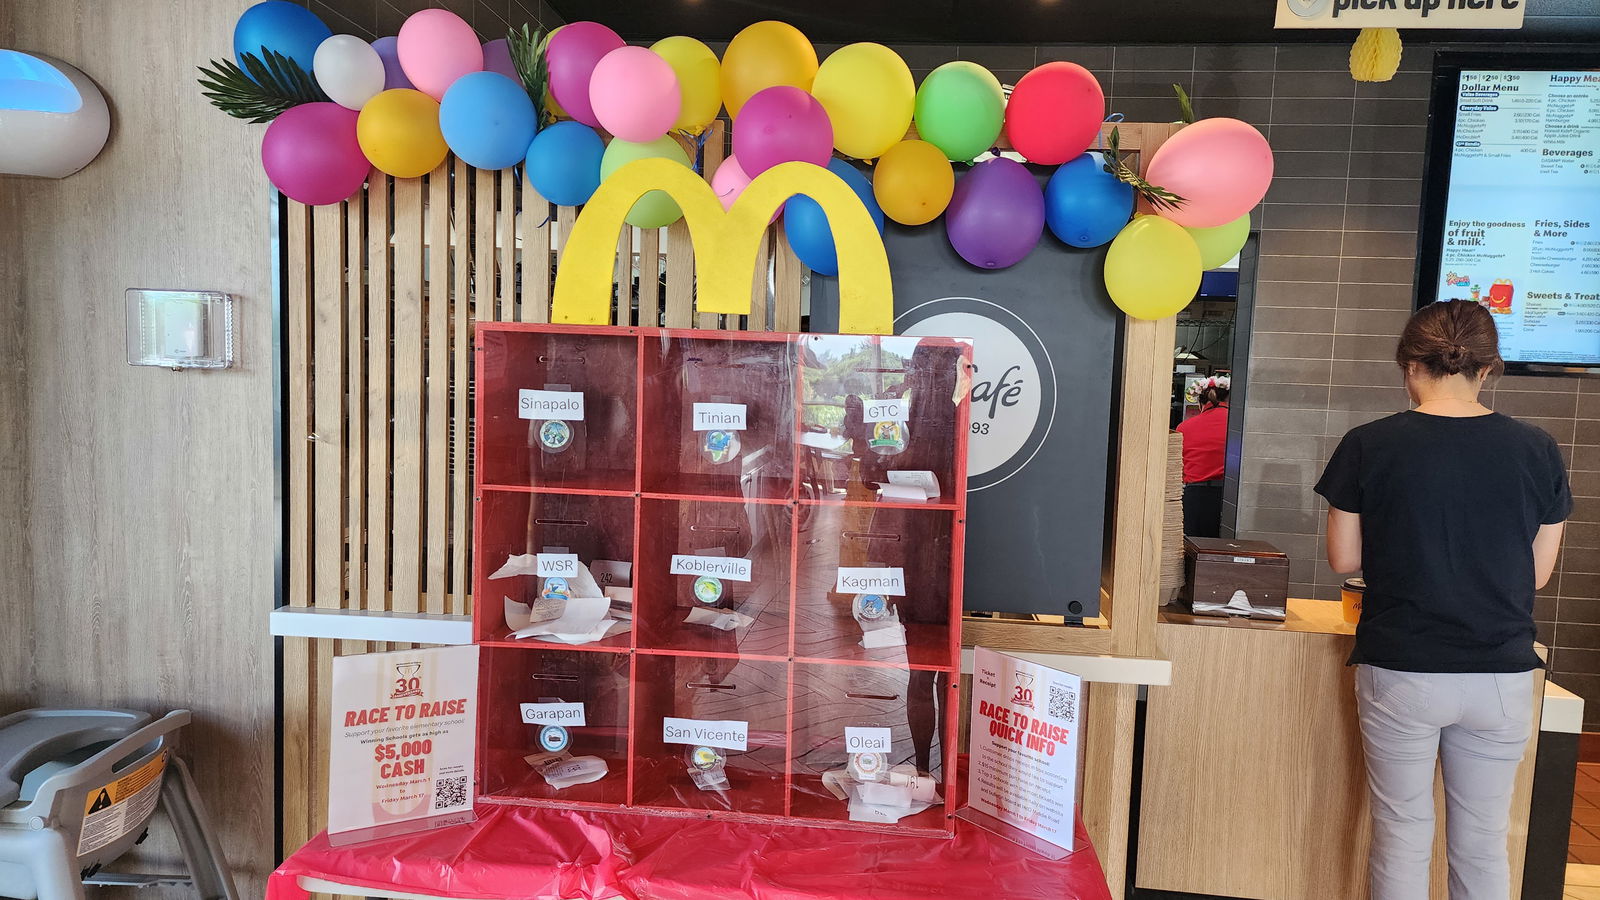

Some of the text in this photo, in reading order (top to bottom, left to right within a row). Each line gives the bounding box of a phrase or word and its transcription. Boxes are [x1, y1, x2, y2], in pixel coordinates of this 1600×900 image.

[1550, 74, 1581, 84] Happy
[1542, 148, 1593, 158] Beverages
[1449, 220, 1470, 228] Enjoy
[1535, 220, 1590, 229] Fries, Sides
[1448, 229, 1485, 237] of fruit
[971, 364, 1024, 419] afé
[520, 397, 579, 412] Sinapalo
[698, 412, 740, 423] Tinian
[869, 405, 898, 418] GTC
[542, 560, 573, 571] WSR
[677, 559, 746, 575] Koblerville
[842, 576, 899, 590] Kagman
[981, 669, 996, 678] Ticket
[395, 677, 420, 693] 30
[979, 678, 996, 688] Receipt
[1014, 685, 1032, 701] 30
[344, 698, 467, 728] RACE TO RAISE
[526, 708, 580, 721] Garapan
[979, 700, 1011, 724] RACE
[1013, 712, 1029, 730] TO
[1031, 718, 1069, 744] RAISE
[345, 729, 369, 738] Support
[666, 726, 745, 742] San Vicente
[990, 720, 1056, 756] QUICK INFO
[360, 736, 384, 745] Winning
[850, 736, 884, 748] Oleai
[375, 739, 432, 762] $5,000
[380, 758, 425, 779] CASH
[376, 780, 408, 790] Wednesday
[980, 797, 1002, 812] Wednesday
